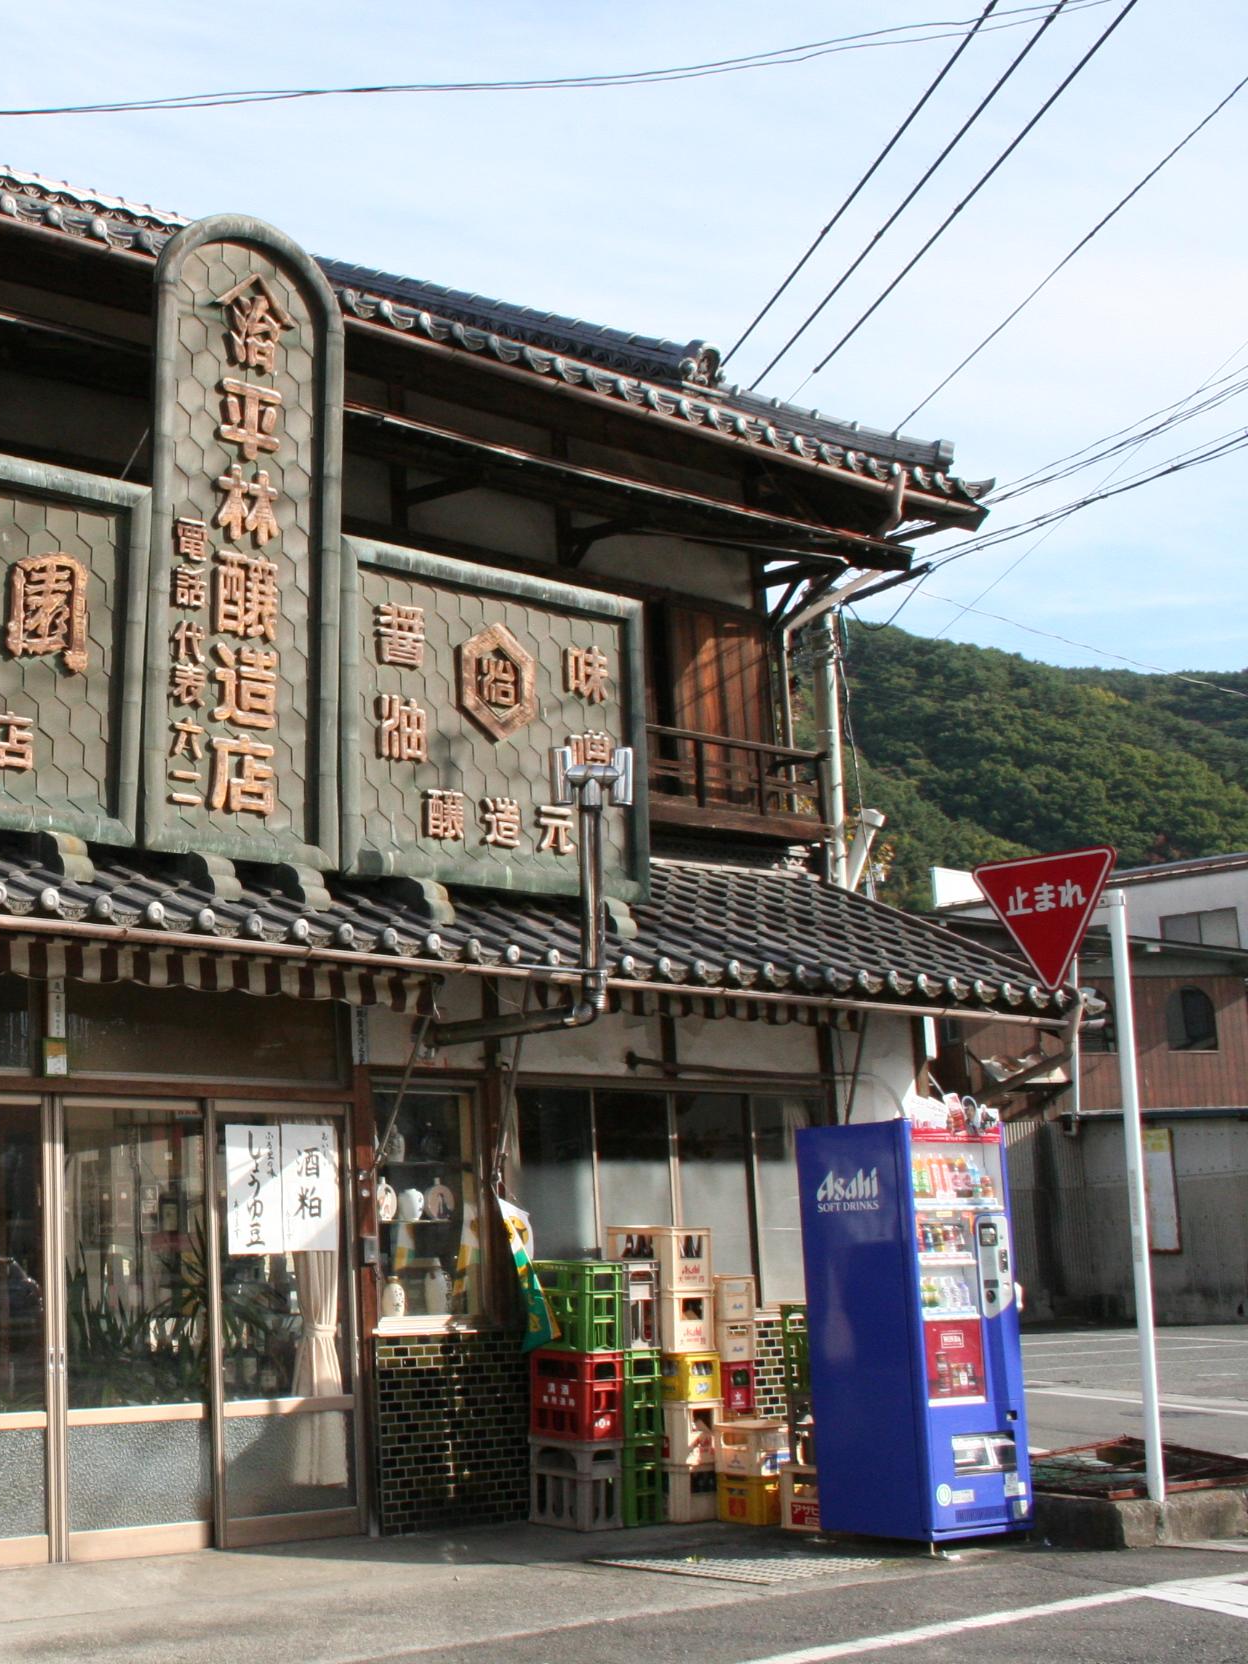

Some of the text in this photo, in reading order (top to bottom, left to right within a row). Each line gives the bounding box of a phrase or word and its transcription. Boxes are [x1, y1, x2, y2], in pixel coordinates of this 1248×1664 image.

[1006, 879, 1087, 917] 止まれ
[245, 1130, 266, 1248] しょうゆ豆
[293, 1147, 322, 1220] 酒粕
[816, 1167, 879, 1202] Asahi
[817, 1200, 880, 1213] SOFT DRINKS
